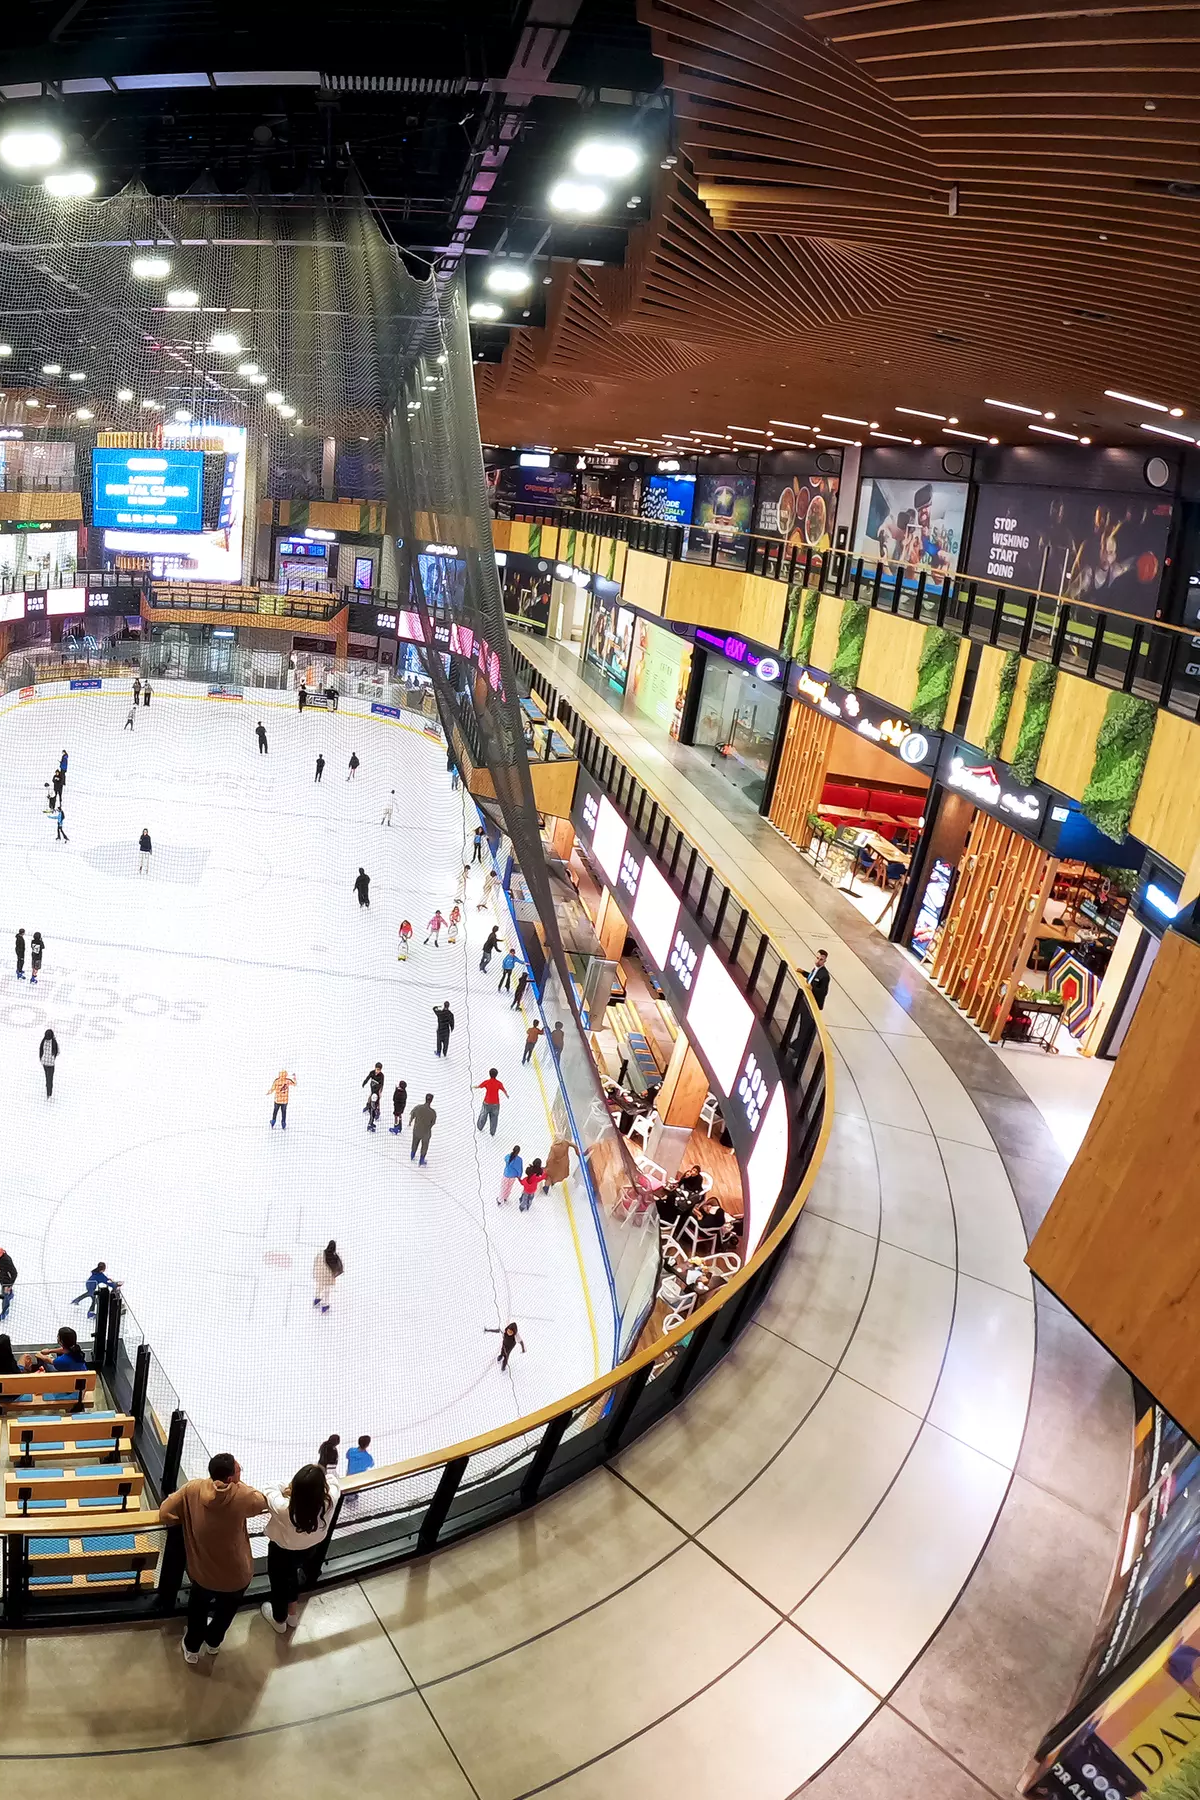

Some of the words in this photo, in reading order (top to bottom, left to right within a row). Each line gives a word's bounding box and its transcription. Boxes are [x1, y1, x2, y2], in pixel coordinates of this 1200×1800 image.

[994, 517, 1017, 530] STOP
[992, 532, 1030, 550] WISHING
[987, 562, 1014, 578] DOING
[990, 548, 1018, 564] START
[674, 930, 698, 972] NOW
[670, 950, 692, 991] OPEN
[744, 1052, 768, 1110] NOW
[739, 1076, 760, 1132] OPEN
